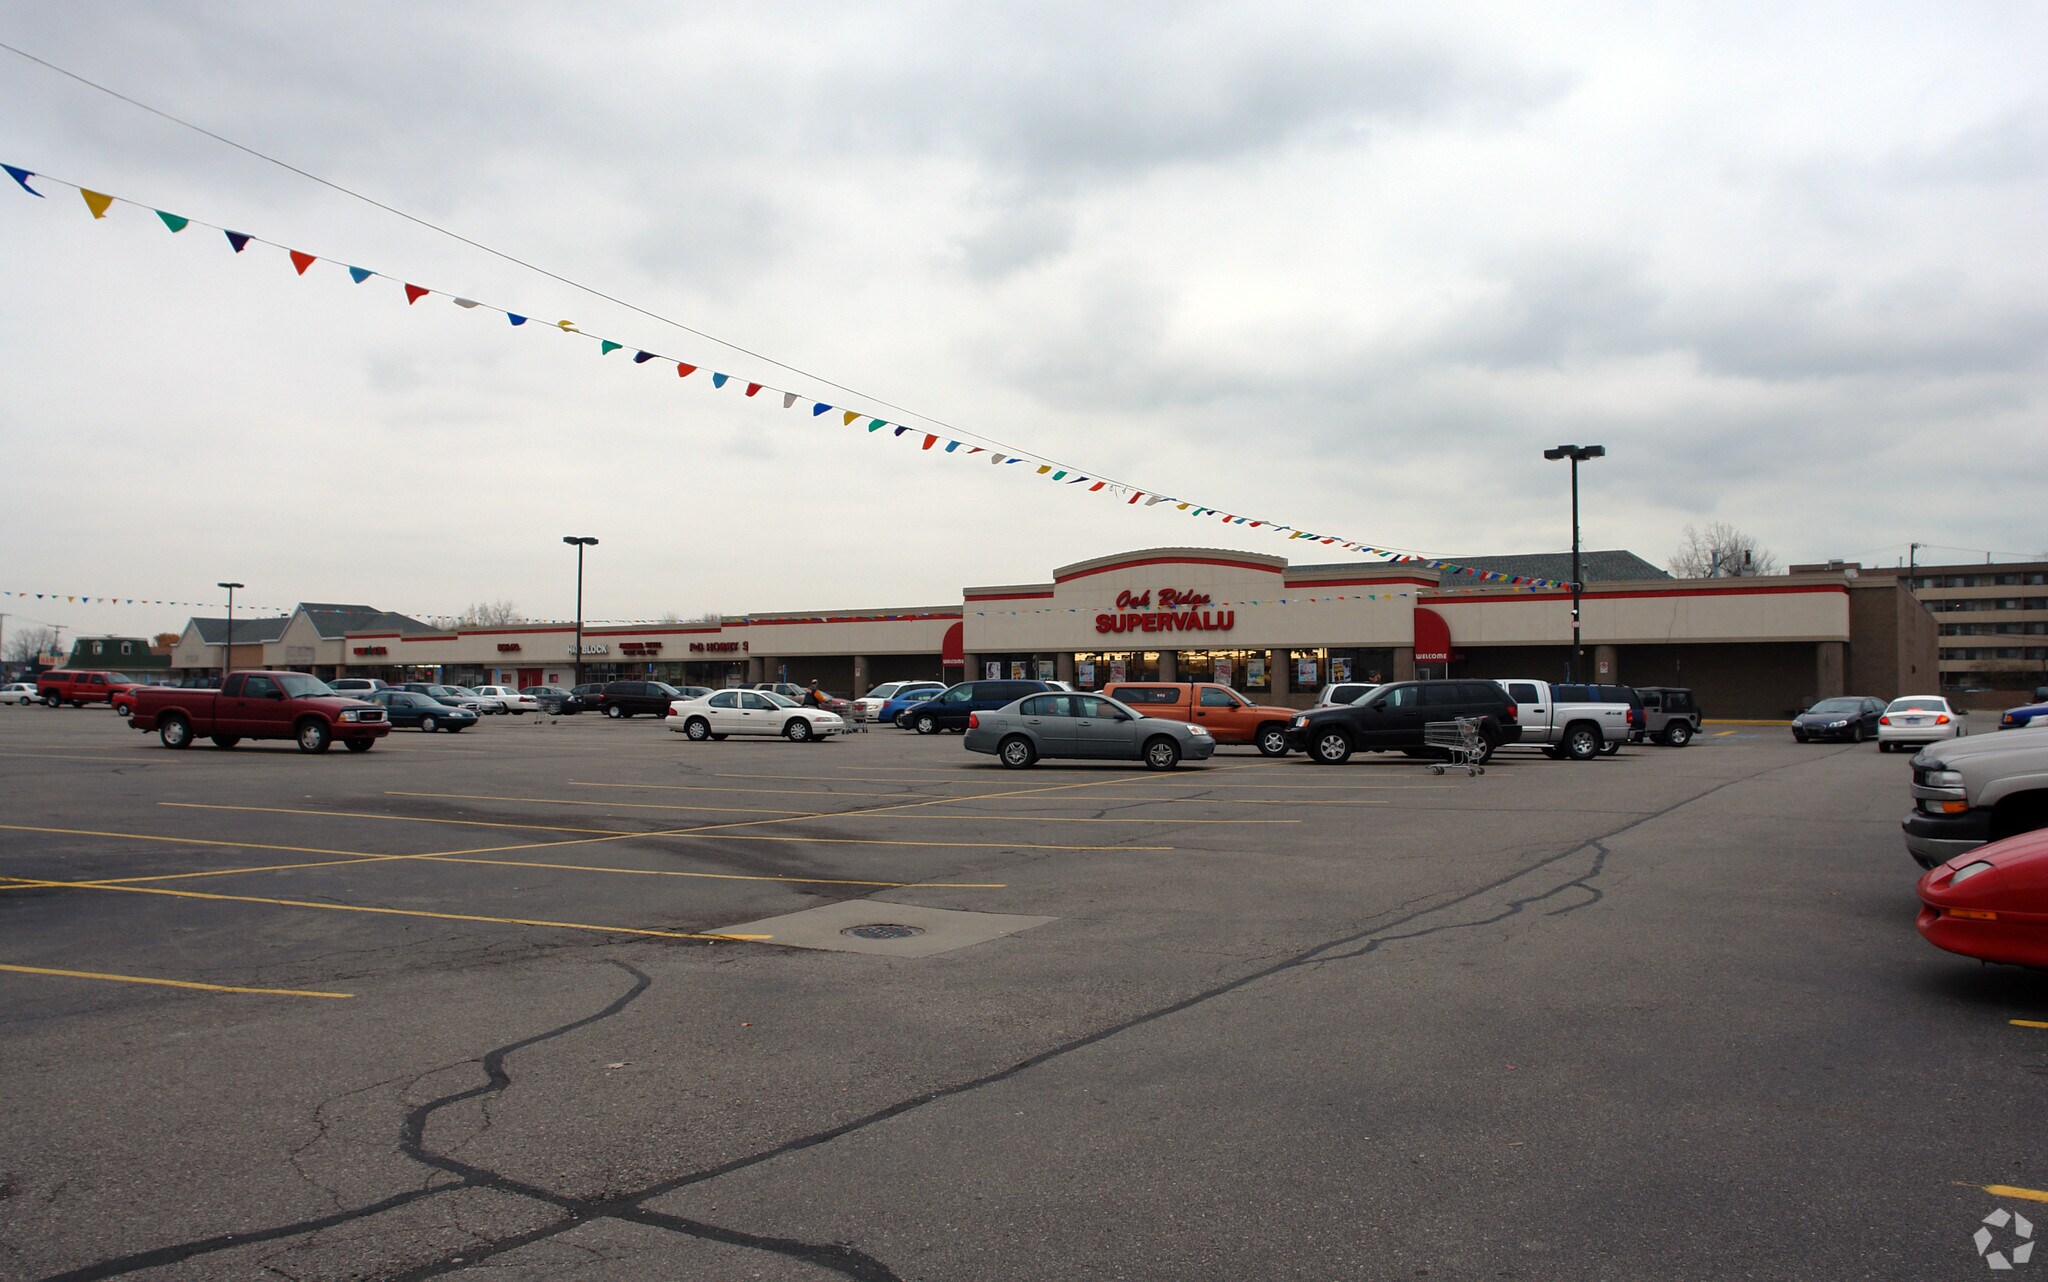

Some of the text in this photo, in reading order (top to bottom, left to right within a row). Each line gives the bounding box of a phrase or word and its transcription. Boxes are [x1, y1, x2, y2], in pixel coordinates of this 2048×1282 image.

[1116, 588, 1211, 611] Oak Ridge
[1095, 611, 1234, 633] SUPERVALU
[581, 644, 608, 654] BLOCK
